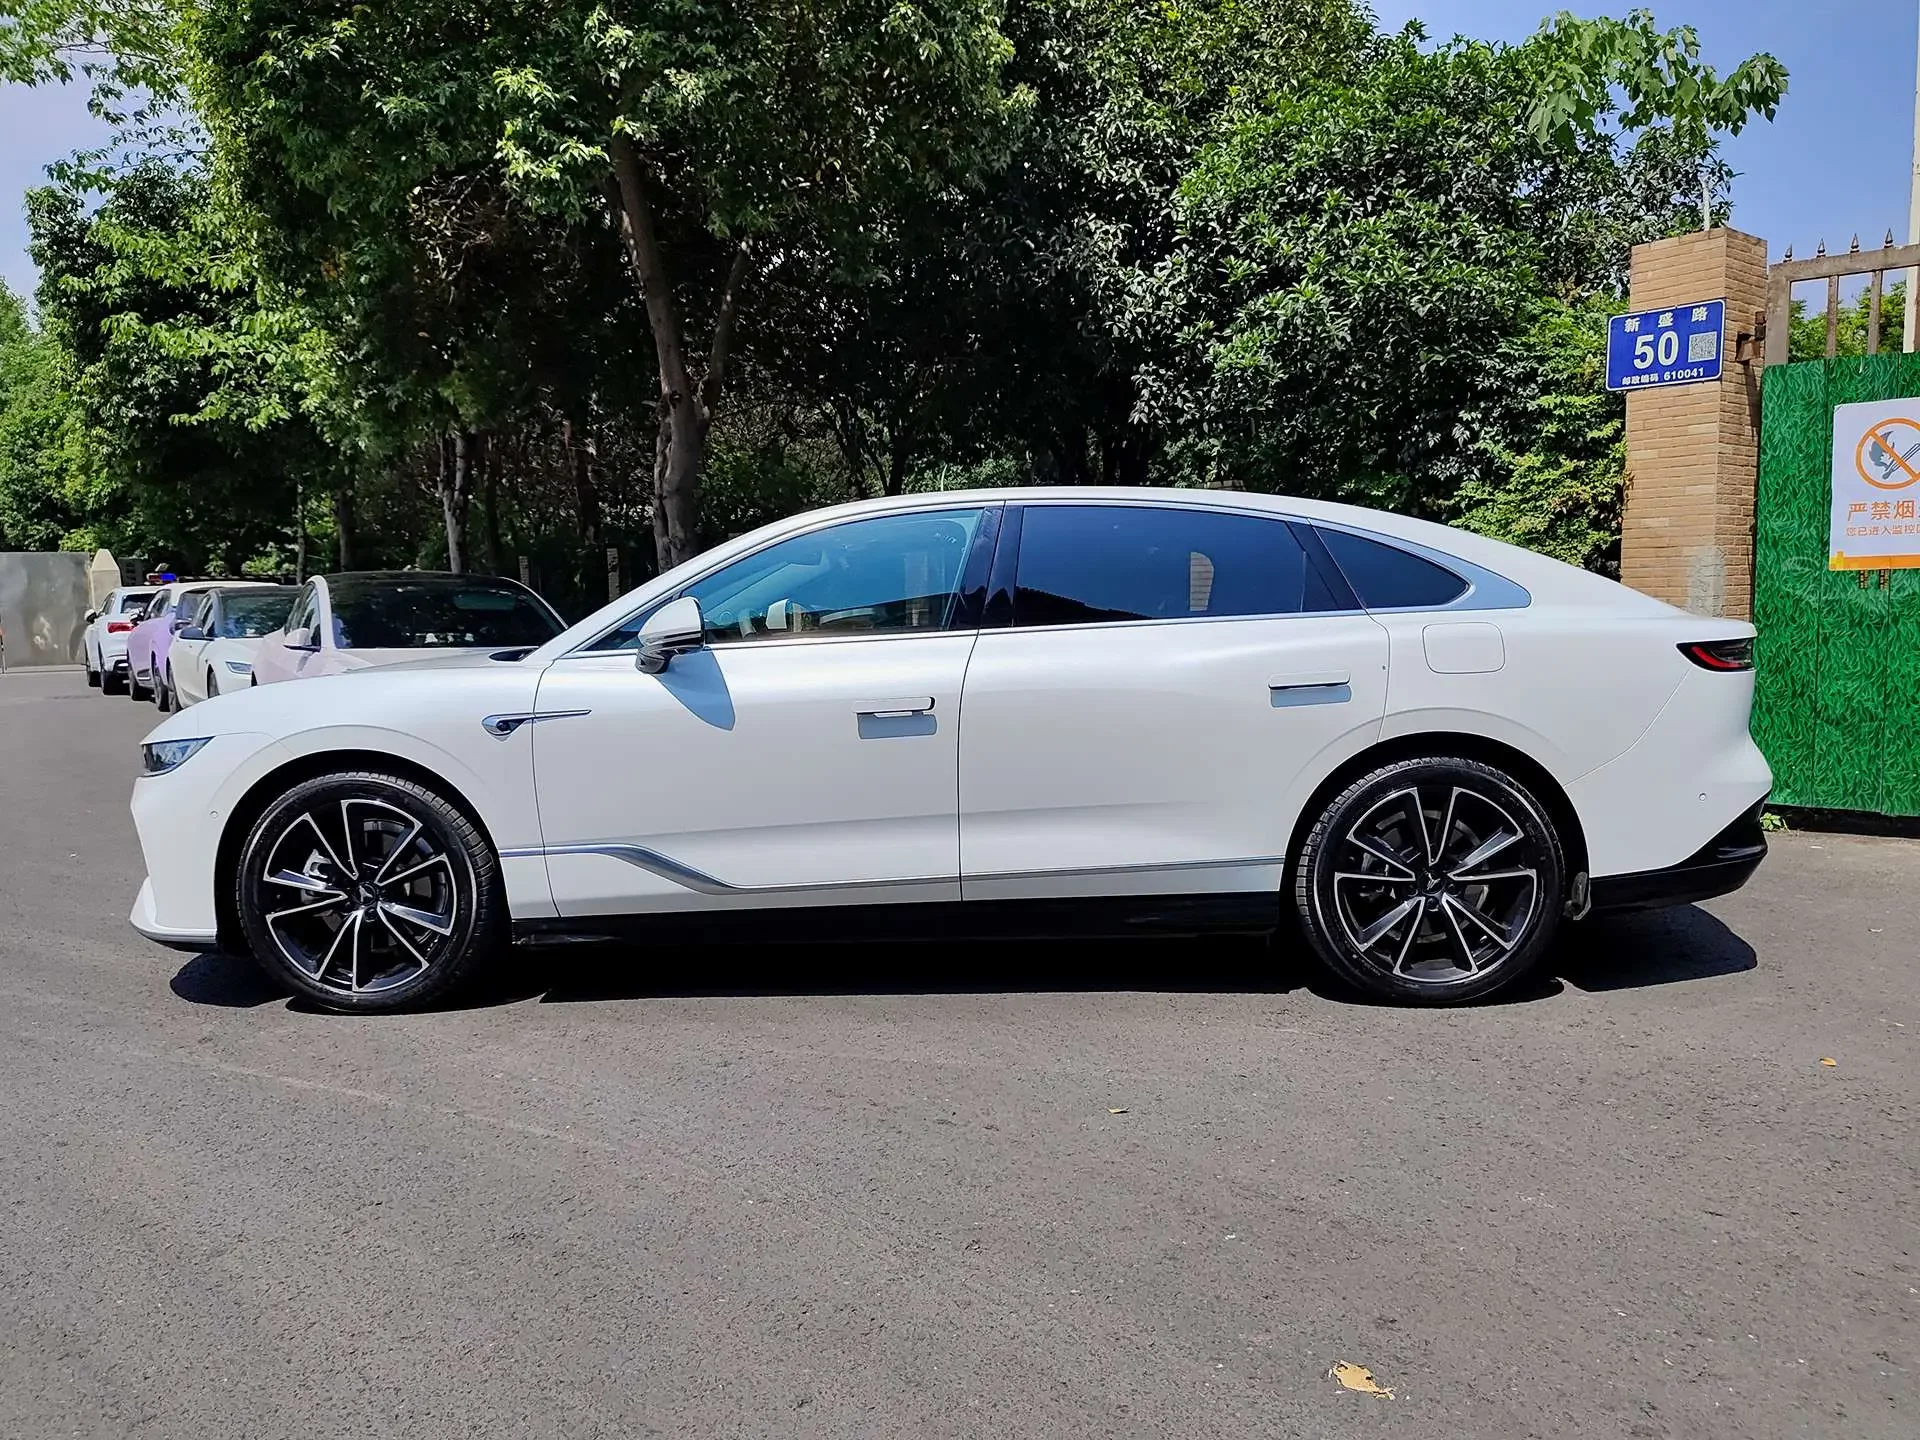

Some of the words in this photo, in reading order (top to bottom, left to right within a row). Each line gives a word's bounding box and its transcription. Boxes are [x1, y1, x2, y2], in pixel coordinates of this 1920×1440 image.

[1624, 307, 1707, 333] 新盛路
[1633, 331, 1679, 369] 50
[1622, 373, 1658, 385] 邮政编码
[1664, 368, 1704, 380] 610041
[1848, 500, 1920, 521] 严禁烟
